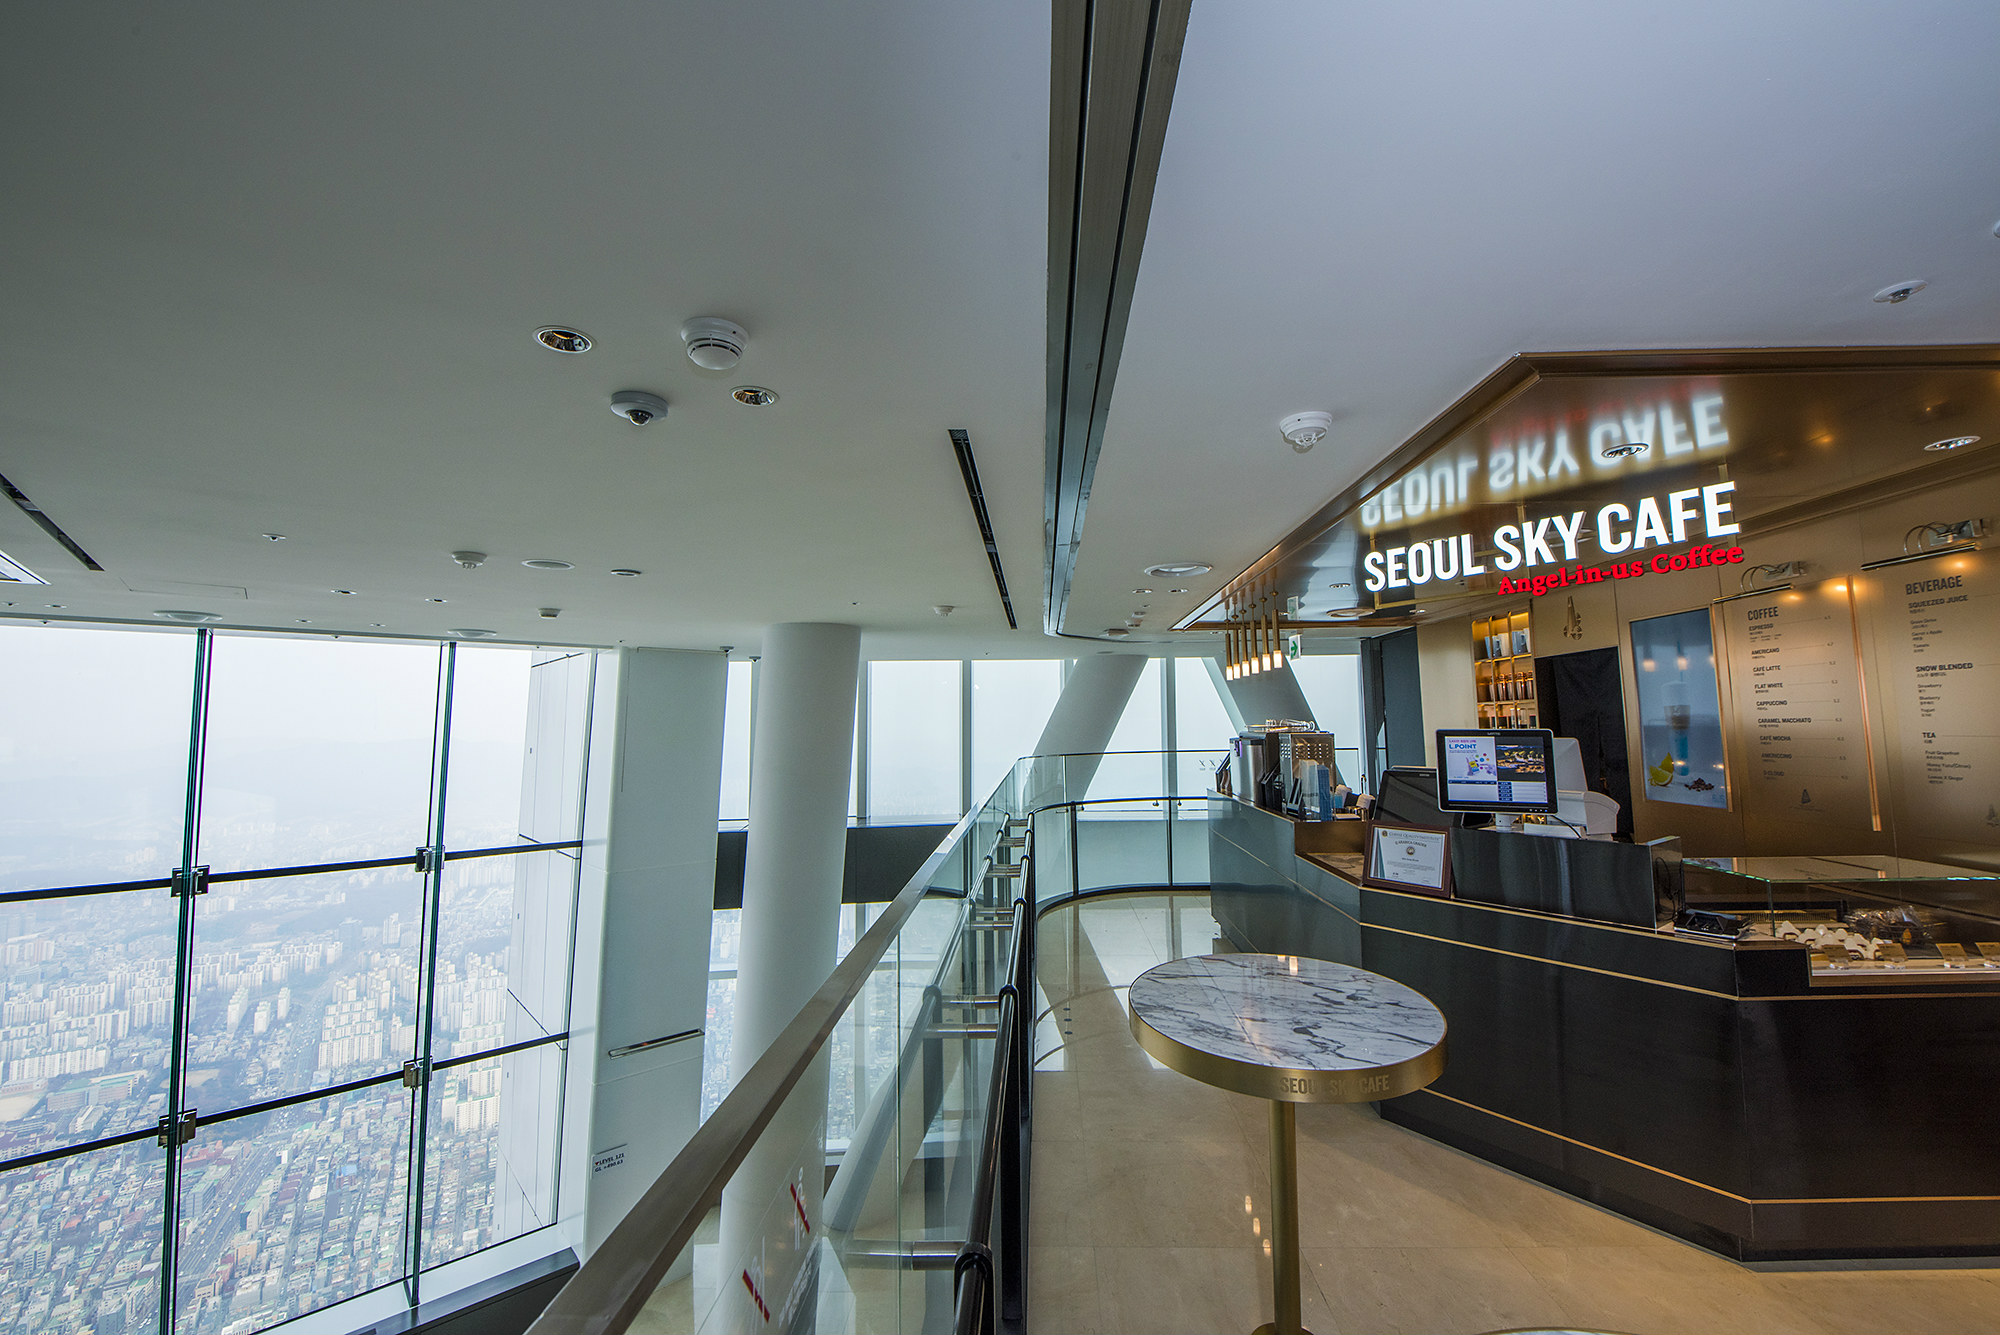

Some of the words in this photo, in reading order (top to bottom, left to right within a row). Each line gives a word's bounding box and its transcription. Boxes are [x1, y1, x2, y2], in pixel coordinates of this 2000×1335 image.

[1363, 533, 1487, 592] SEOUL
[1493, 510, 1586, 571] SKY
[1597, 480, 1741, 554] CAFE
[1498, 561, 1643, 597] Angel-in-us
[1650, 544, 1744, 574] Coffee
[1905, 575, 1963, 595] BEVERAGE
[1908, 598, 1945, 608] SQUEEZED
[1946, 595, 1968, 603] JUICE
[1747, 606, 1779, 621] COFFEE
[1749, 623, 1774, 631] ESPRESSO
[1751, 647, 1780, 655] AMERICANO
[1938, 662, 1973, 671] BLENDED
[1280, 1077, 1319, 1095] SEOU
[1360, 1074, 1390, 1094] CAFE
